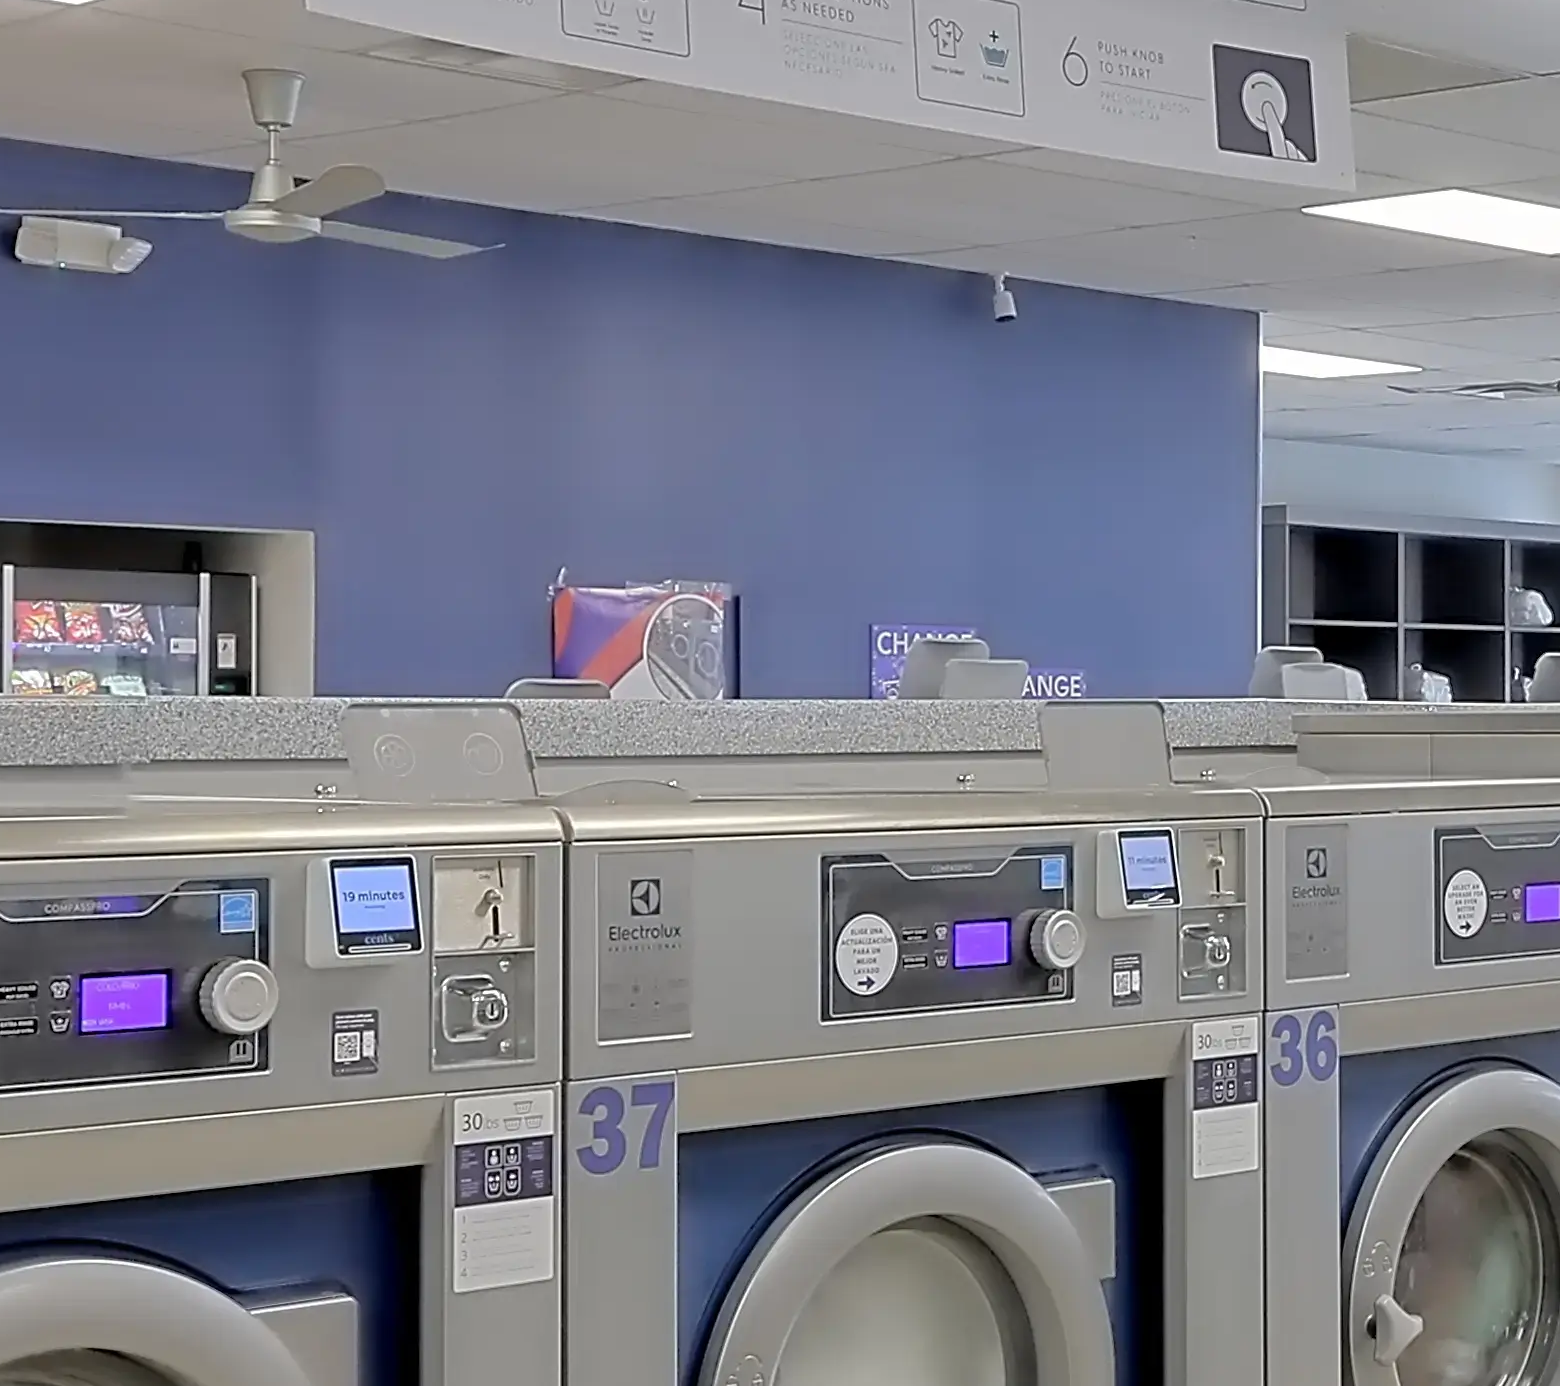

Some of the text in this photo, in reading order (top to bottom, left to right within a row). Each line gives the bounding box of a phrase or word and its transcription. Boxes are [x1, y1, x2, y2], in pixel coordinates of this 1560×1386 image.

[802, 1, 856, 23] NEEDED
[1062, 35, 1089, 87] 6
[1097, 40, 1165, 65] PUSH KNOB
[1099, 60, 1152, 81] TO START
[342, 889, 406, 903] 19 minutes
[608, 923, 682, 941] Electrolux
[1197, 1033, 1213, 1050] 30
[1269, 1008, 1338, 1088] 36
[461, 1112, 483, 1132] 30
[574, 1081, 676, 1176] 37
[460, 1232, 468, 1244] 2
